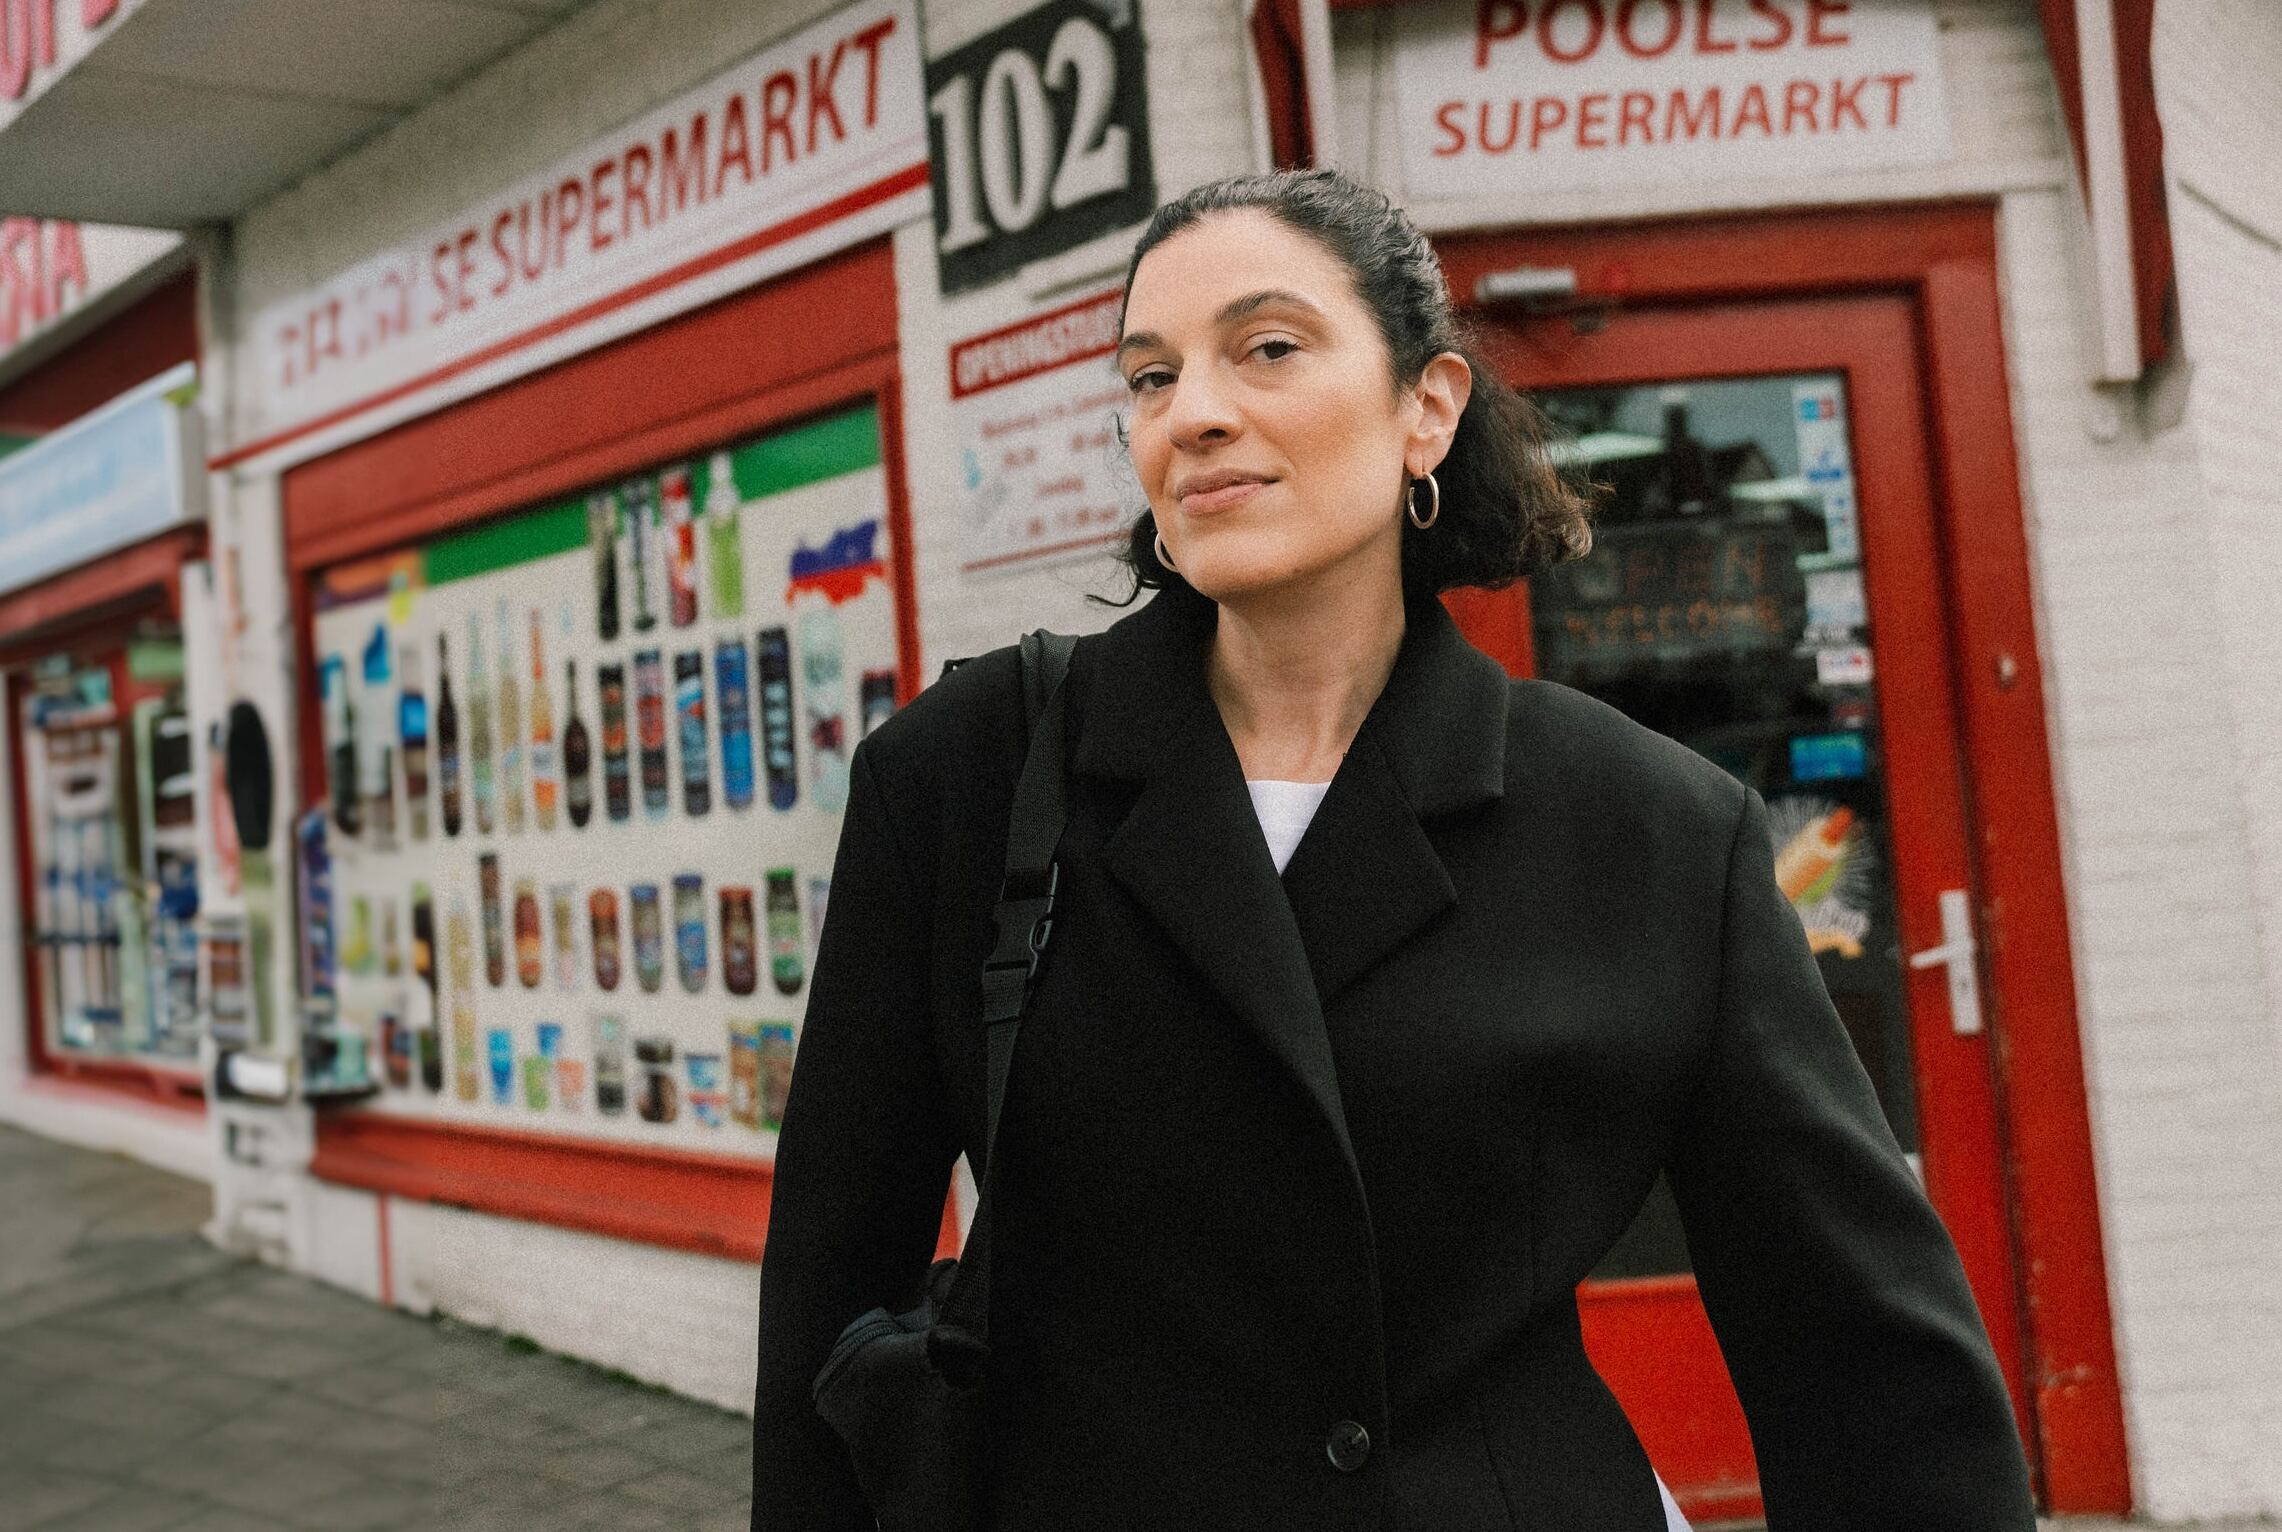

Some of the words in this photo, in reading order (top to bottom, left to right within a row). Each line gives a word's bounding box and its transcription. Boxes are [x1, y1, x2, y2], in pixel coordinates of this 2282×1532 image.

[1474, 0, 1852, 69] POOLSE
[490, 15, 896, 299] SUPERMARKT
[931, 17, 1130, 252] 102
[1432, 73, 1915, 158] SUPERMARKT
